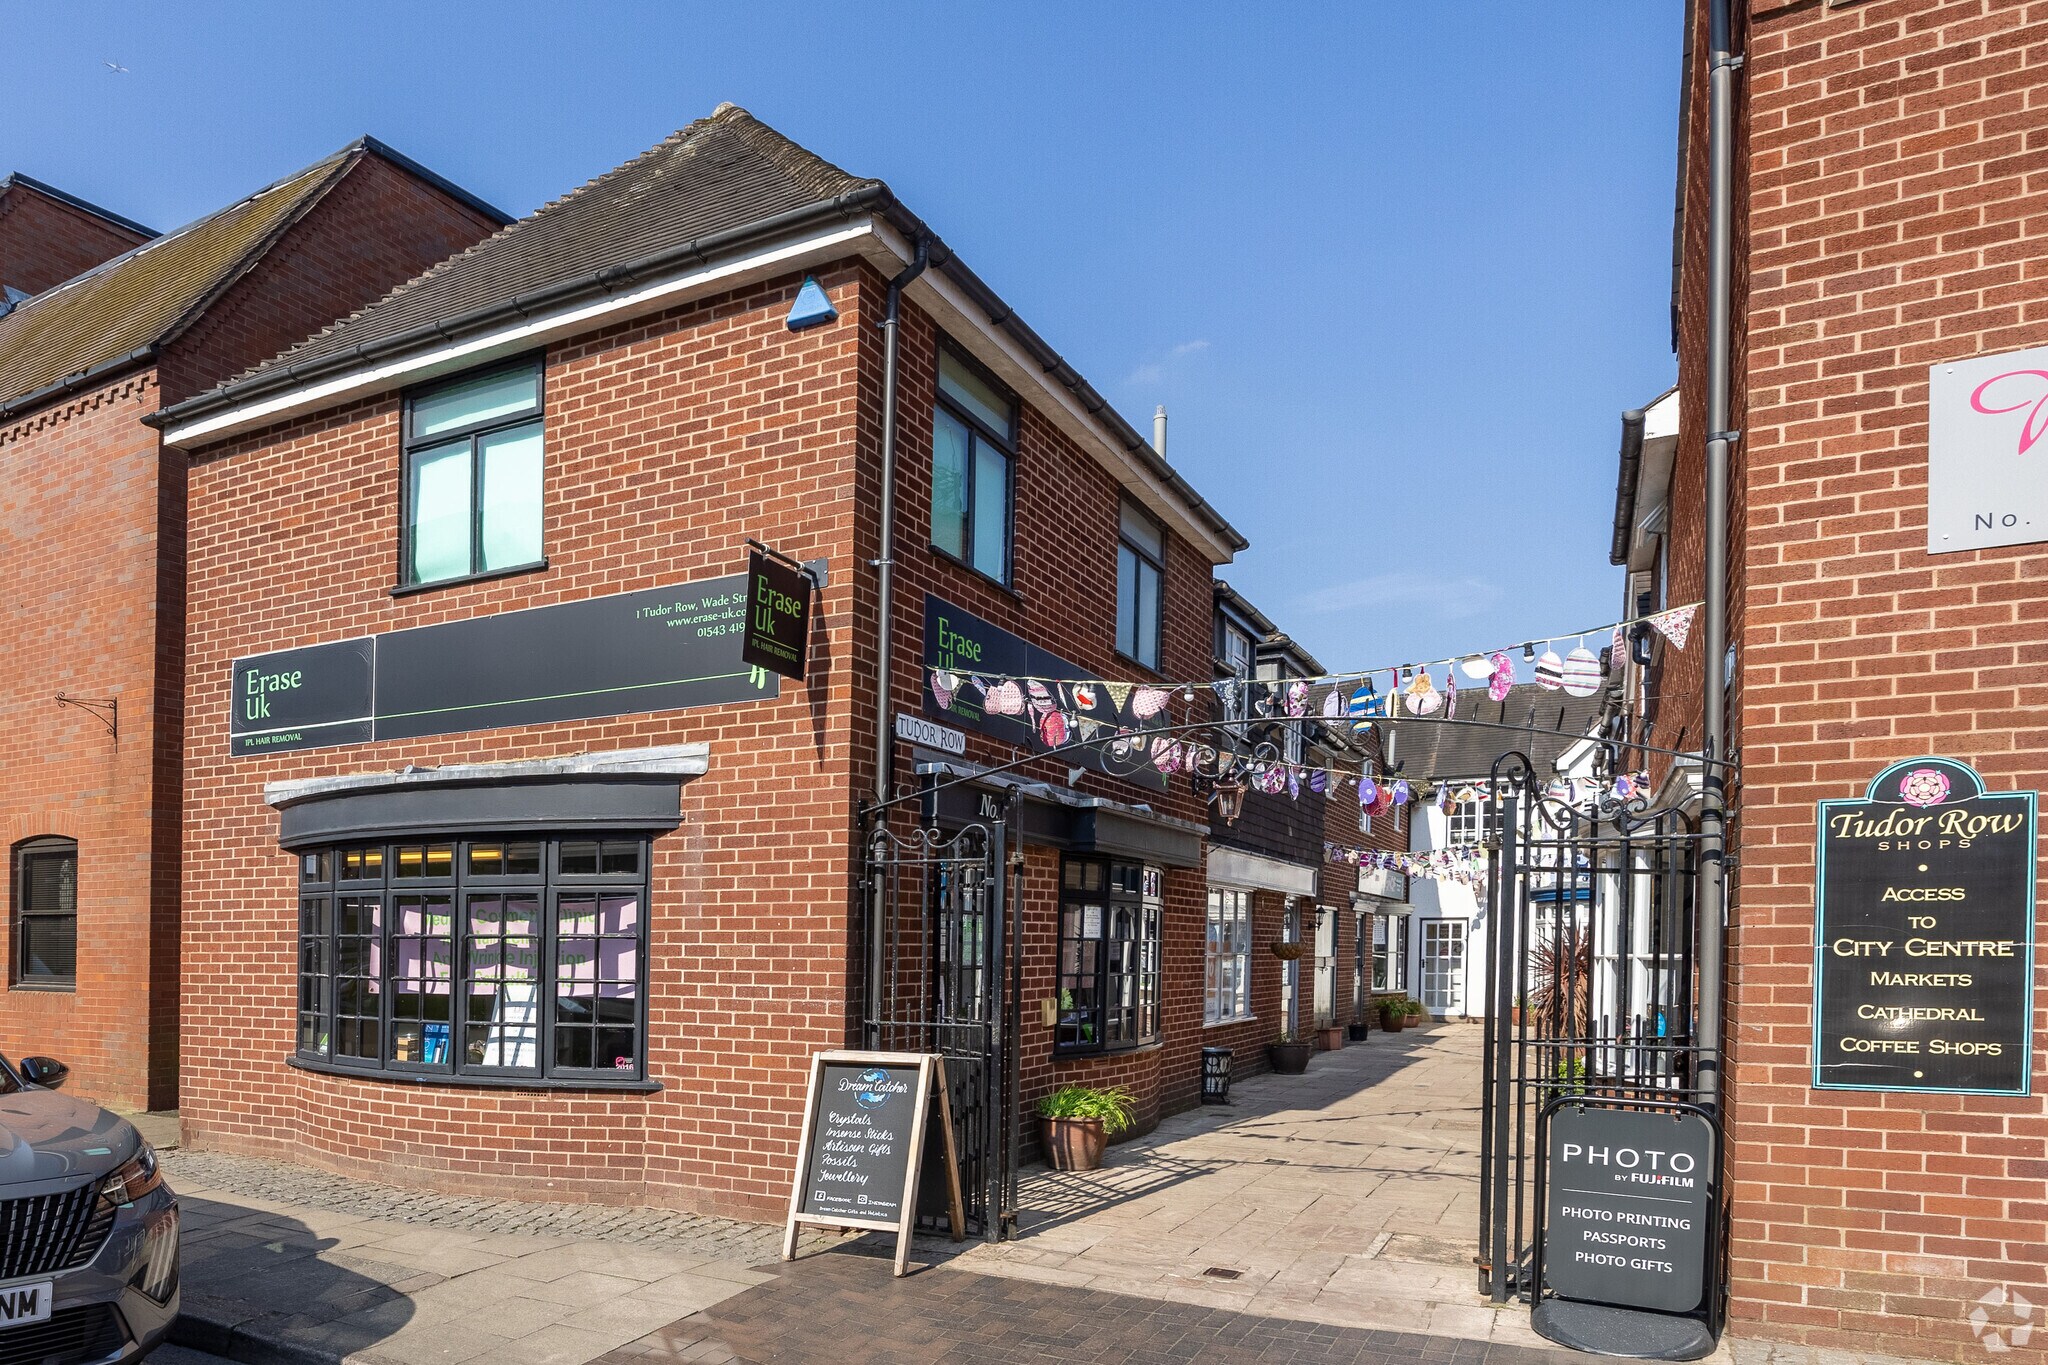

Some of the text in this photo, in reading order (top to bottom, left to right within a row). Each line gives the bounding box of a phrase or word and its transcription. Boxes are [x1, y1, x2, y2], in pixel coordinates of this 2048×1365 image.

[1975, 512, 2030, 531] No.
[643, 604, 672, 618] Tudor
[675, 602, 698, 613] Row,
[702, 594, 729, 609] Wade
[732, 593, 747, 603] Str
[757, 574, 801, 618] Erase
[667, 607, 747, 627] www.erase-uk.co
[755, 605, 776, 636] Uk
[697, 621, 746, 637] 01543 419
[938, 616, 982, 662] Erase
[760, 641, 773, 653] HAIR
[773, 645, 798, 662] REMOVAL
[246, 669, 302, 695] Erase
[245, 694, 271, 720] Uk
[245, 733, 302, 747] IPL HAIR REMOVAL
[899, 717, 964, 751] TUDOR ROW
[979, 793, 999, 819] No.
[1830, 808, 2024, 839] Tudor Row
[1878, 839, 1971, 851] SHOPS
[838, 1077, 908, 1094] Dream Catcher
[829, 1111, 872, 1127] Crystals
[864, 1127, 894, 1141] Sticks
[822, 1139, 891, 1157] Artisan Gifts
[1562, 1143, 1695, 1173] PHOTO
[821, 1153, 858, 1168] Fossils
[818, 1169, 869, 1186] Jewellery
[1562, 1206, 1691, 1230] PHOTO PRINTING
[1583, 1230, 1666, 1250] PASSPORTS
[1575, 1251, 1673, 1273] PHOTO GIFTS
